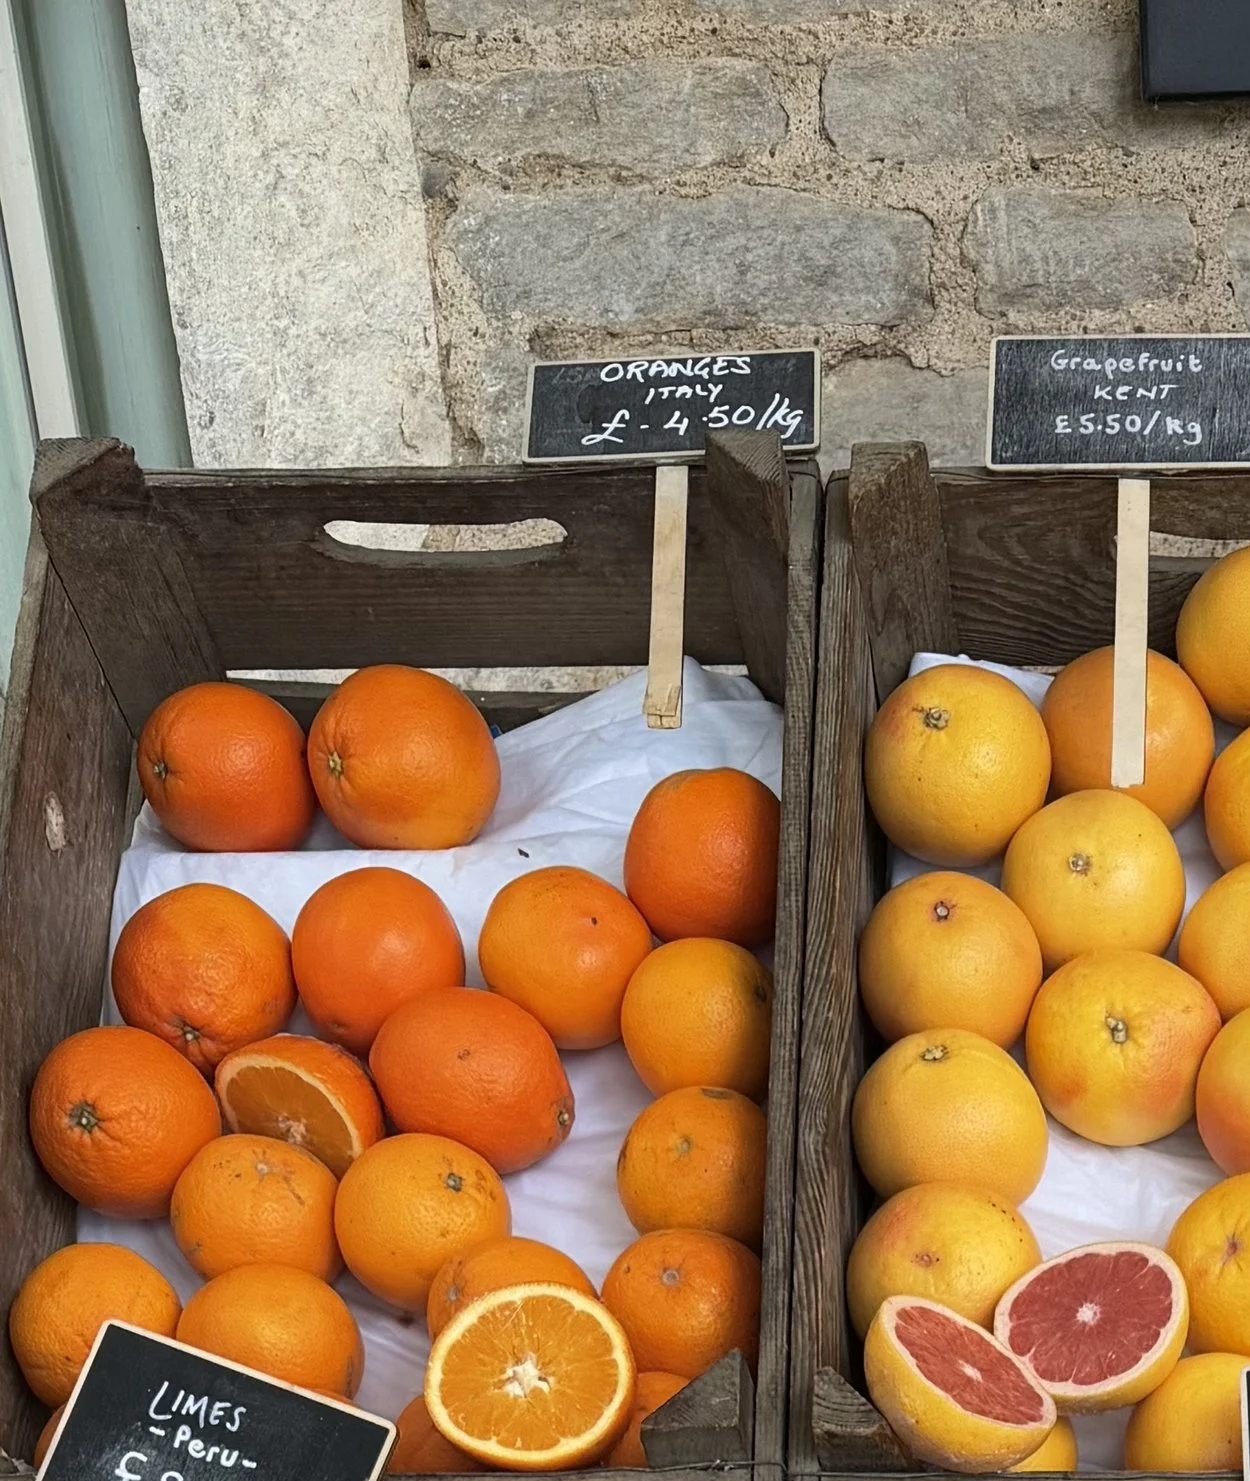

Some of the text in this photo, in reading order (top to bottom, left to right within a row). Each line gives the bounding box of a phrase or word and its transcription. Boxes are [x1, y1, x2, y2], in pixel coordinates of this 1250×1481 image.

[600, 356, 750, 383] ORANGES
[1050, 350, 1203, 379] Grapefruit
[644, 384, 723, 404] ITALY
[1094, 384, 1180, 400] KENT
[149, 1381, 247, 1432] LIMES
